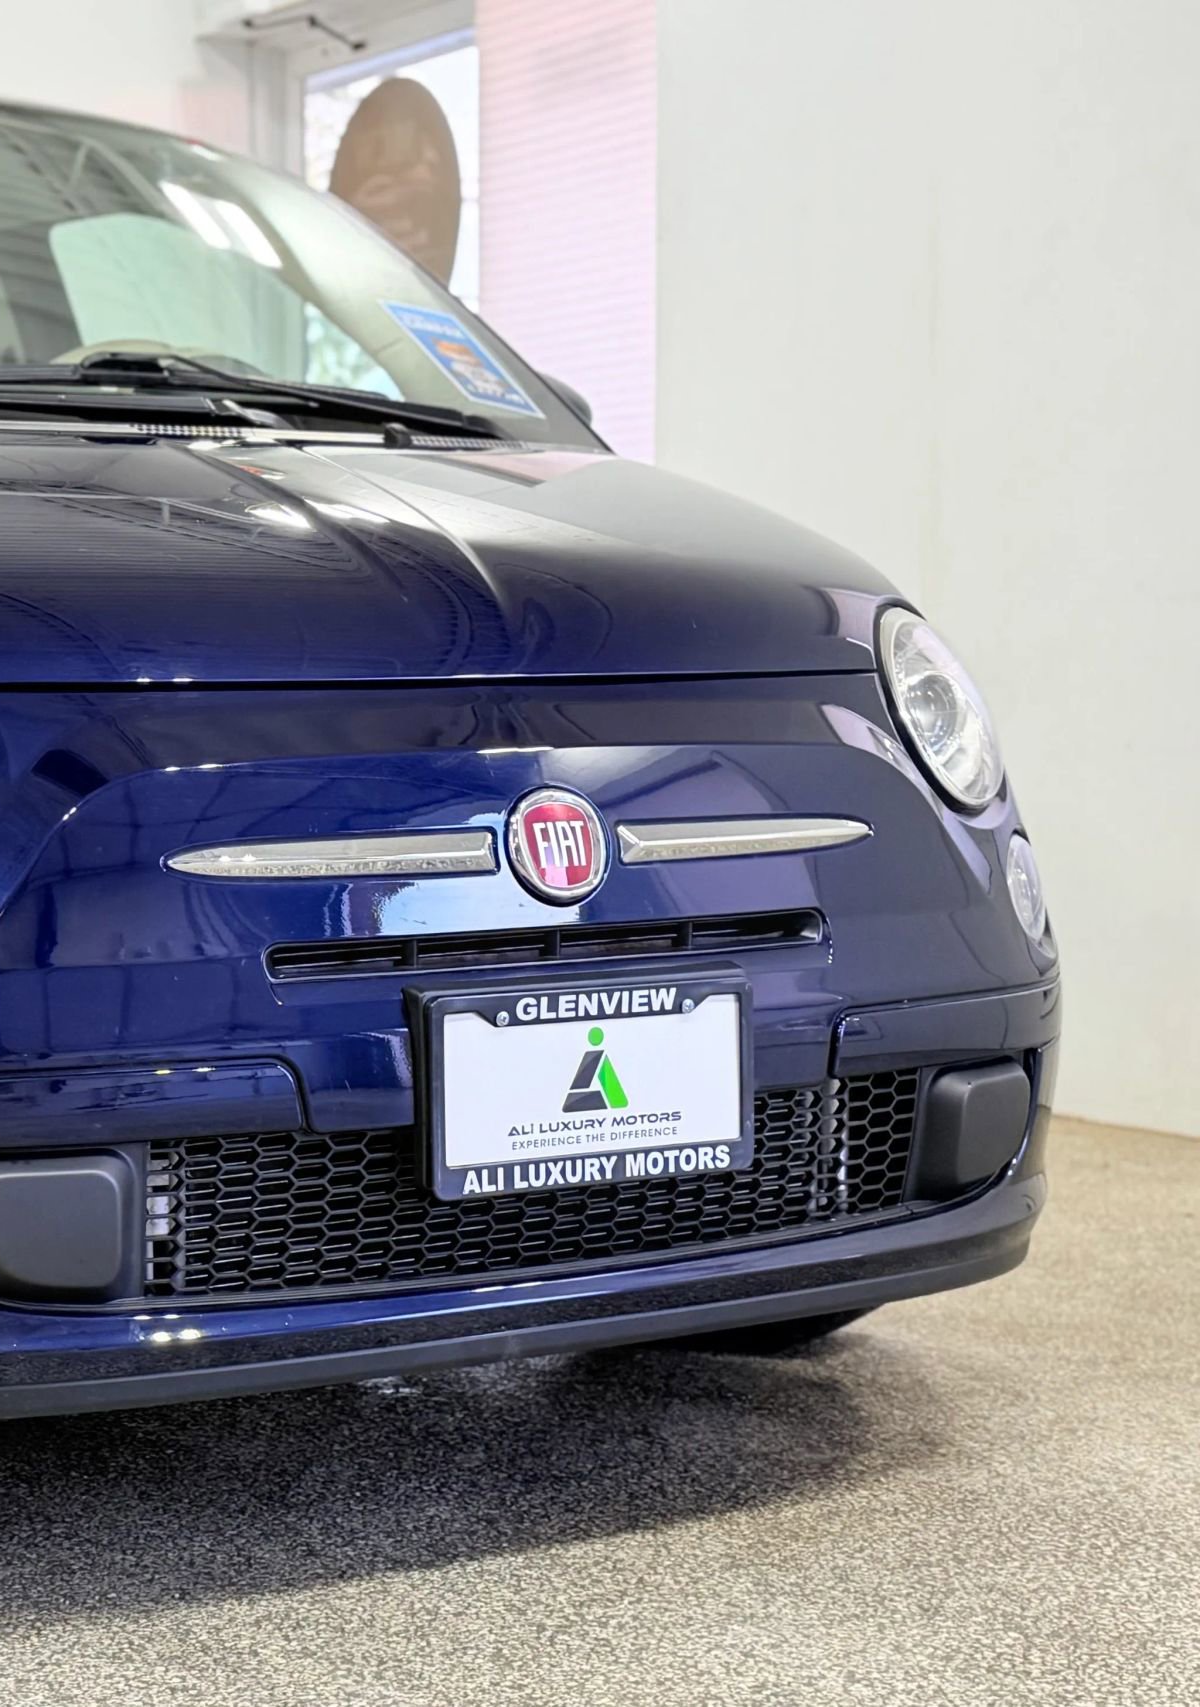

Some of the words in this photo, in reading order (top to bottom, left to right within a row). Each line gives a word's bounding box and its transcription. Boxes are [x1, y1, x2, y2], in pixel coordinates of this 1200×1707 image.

[532, 820, 587, 869] FIAT
[516, 987, 677, 1021] GLENVIEW
[511, 1135, 582, 1151] EXPERIENCE
[585, 1133, 606, 1142] THE
[610, 1127, 678, 1141] DIFFERENCE
[539, 1118, 606, 1134] LUXURY
[611, 1111, 682, 1127] MOTORS
[462, 1166, 505, 1195] ALI
[513, 1156, 618, 1189] LUXURY
[624, 1144, 731, 1178] MOTORS
